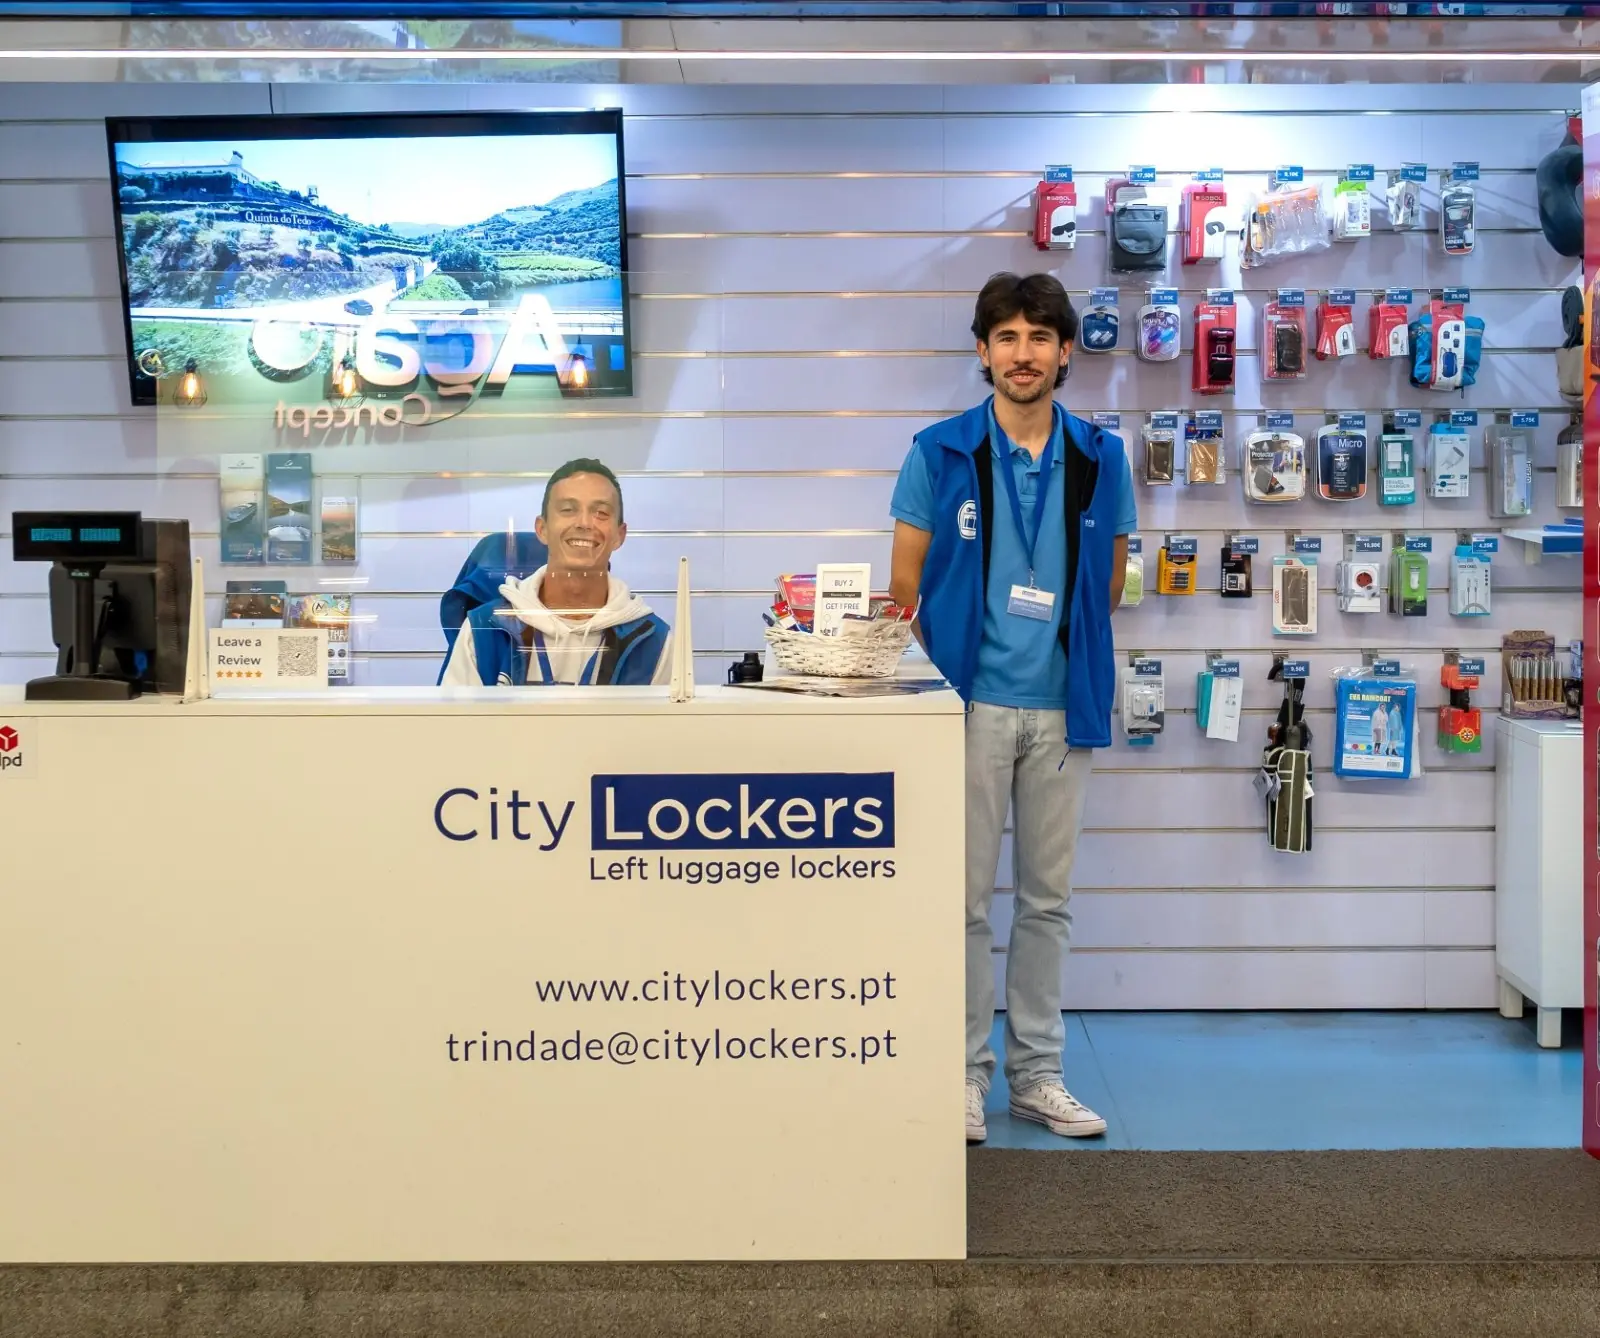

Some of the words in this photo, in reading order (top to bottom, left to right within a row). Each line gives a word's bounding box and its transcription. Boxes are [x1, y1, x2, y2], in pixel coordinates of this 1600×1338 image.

[246, 211, 278, 222] Quinta
[280, 214, 291, 224] do
[291, 214, 312, 225] Tedo
[1338, 438, 1362, 448] Micro
[217, 636, 252, 647] Leave
[254, 638, 262, 647] a
[218, 655, 262, 666] Review
[0, 752, 22, 770] pd
[434, 787, 576, 852] City
[605, 784, 884, 840] Lockers
[590, 856, 649, 881] Left
[658, 856, 780, 884] luggage
[791, 854, 896, 880] lockers
[535, 970, 898, 1008] www.citylockers.pt
[446, 1028, 898, 1066] trindade@citylockers.pt
